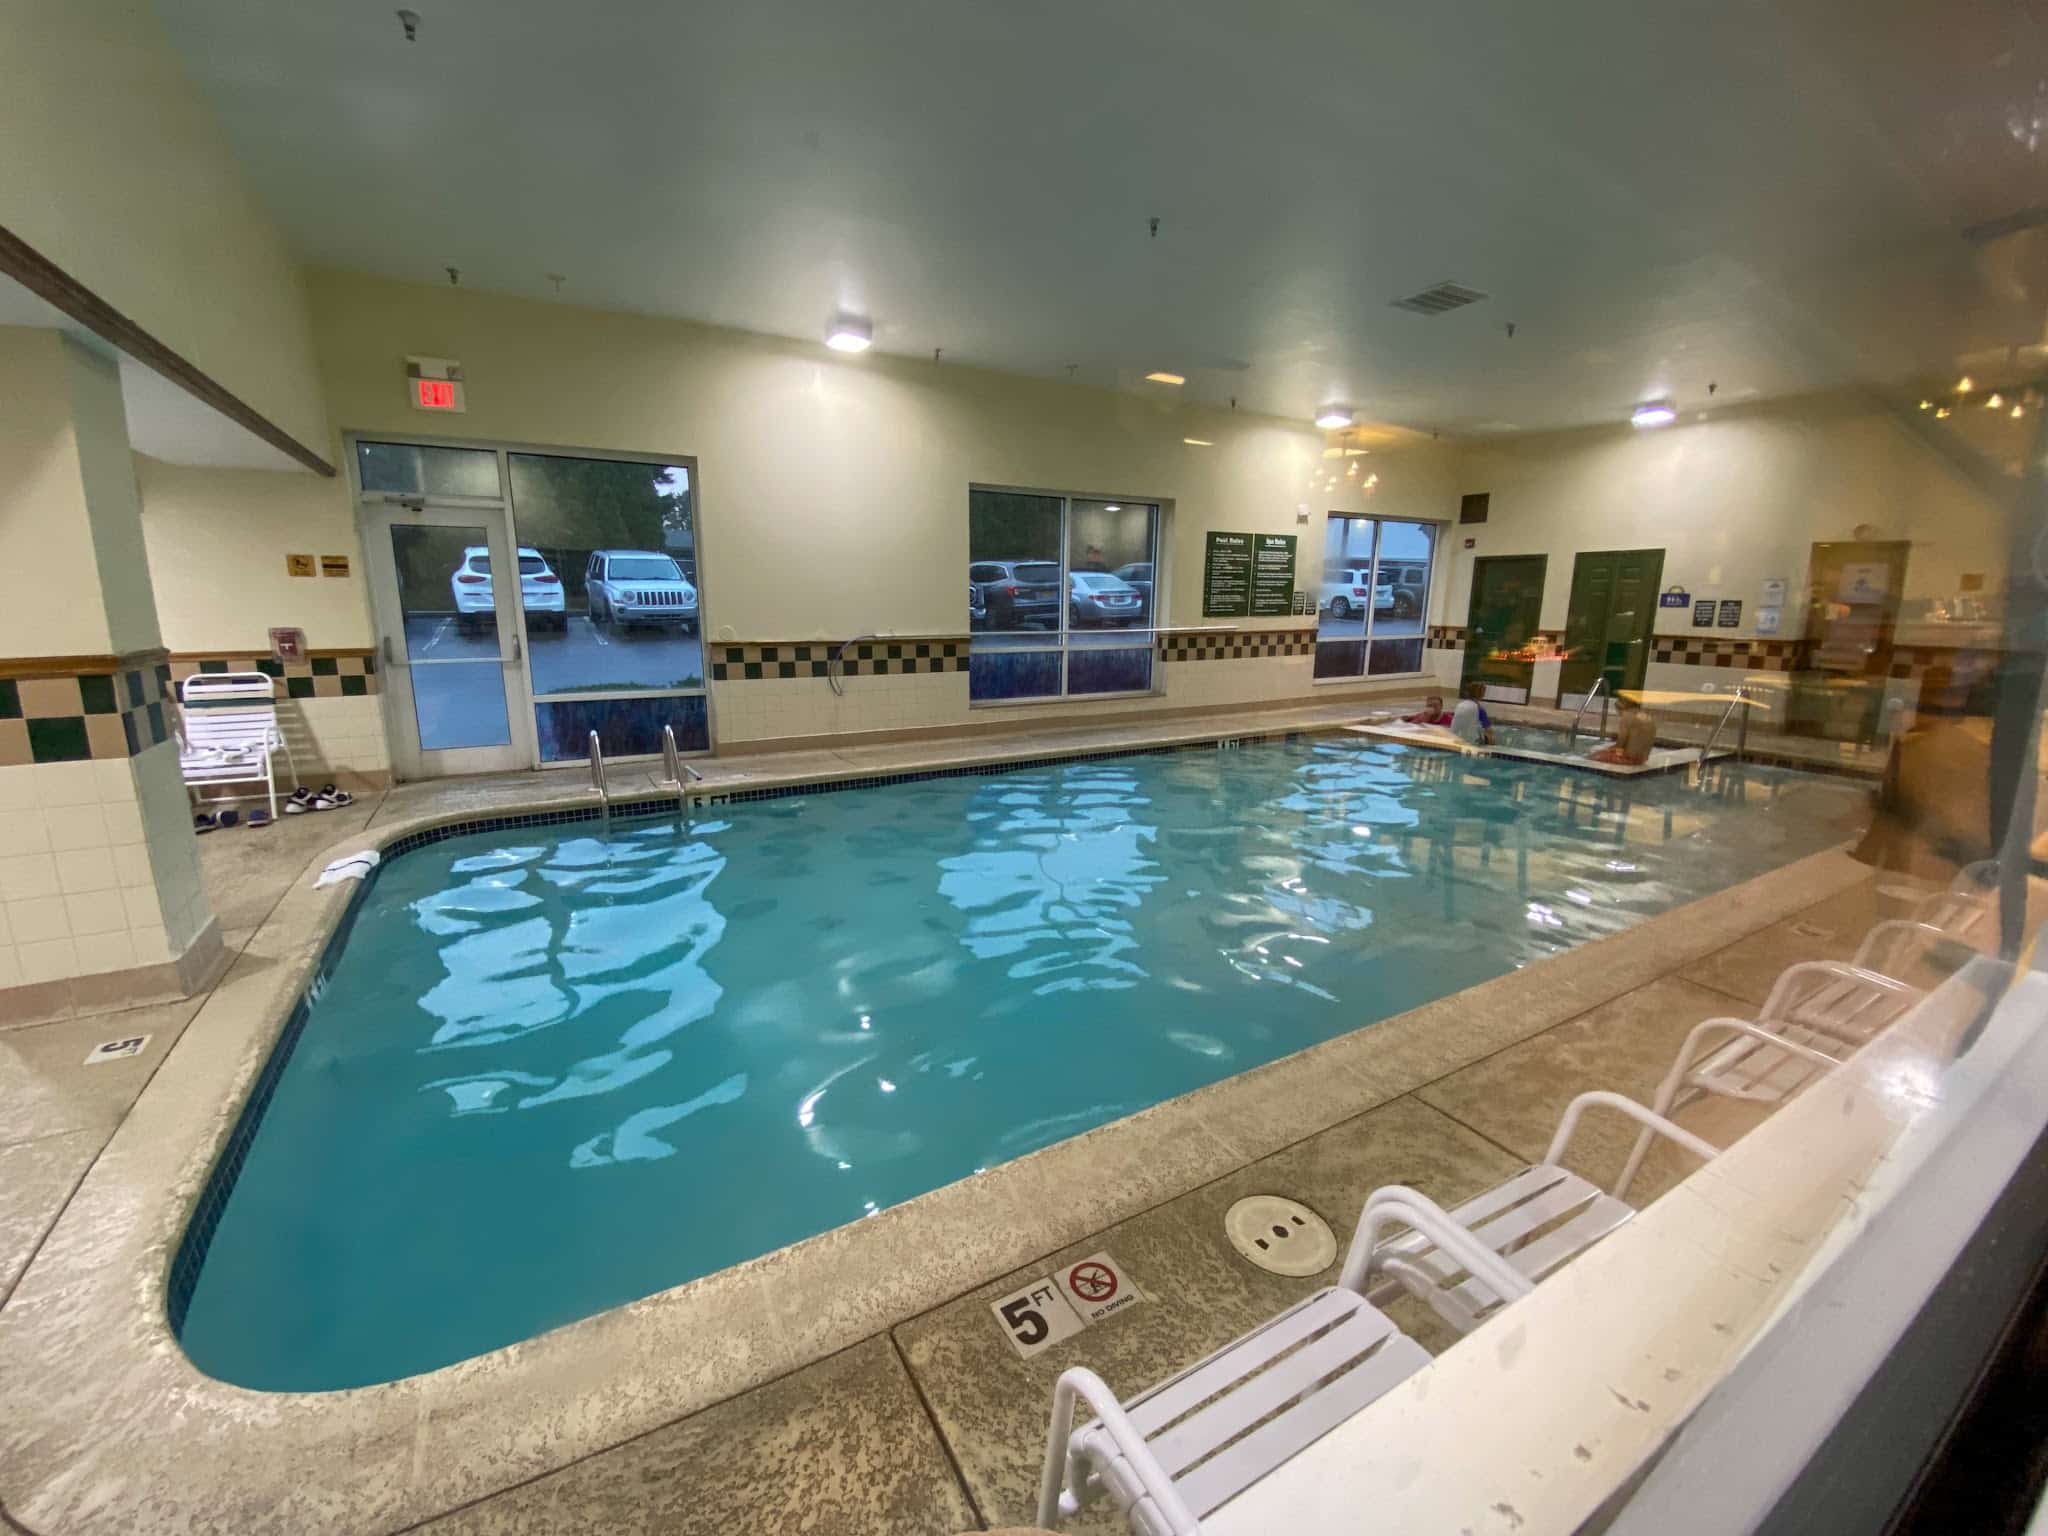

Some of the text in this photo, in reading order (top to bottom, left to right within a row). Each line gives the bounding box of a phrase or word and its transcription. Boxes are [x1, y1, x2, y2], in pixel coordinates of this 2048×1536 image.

[419, 380, 454, 408] EXIT
[1216, 536, 1228, 544] Pool
[710, 794, 728, 807] FT
[101, 1037, 144, 1053] 5
[1000, 1286, 1055, 1345] 5 FT
[1091, 1293, 1135, 1320] NO DIVING
